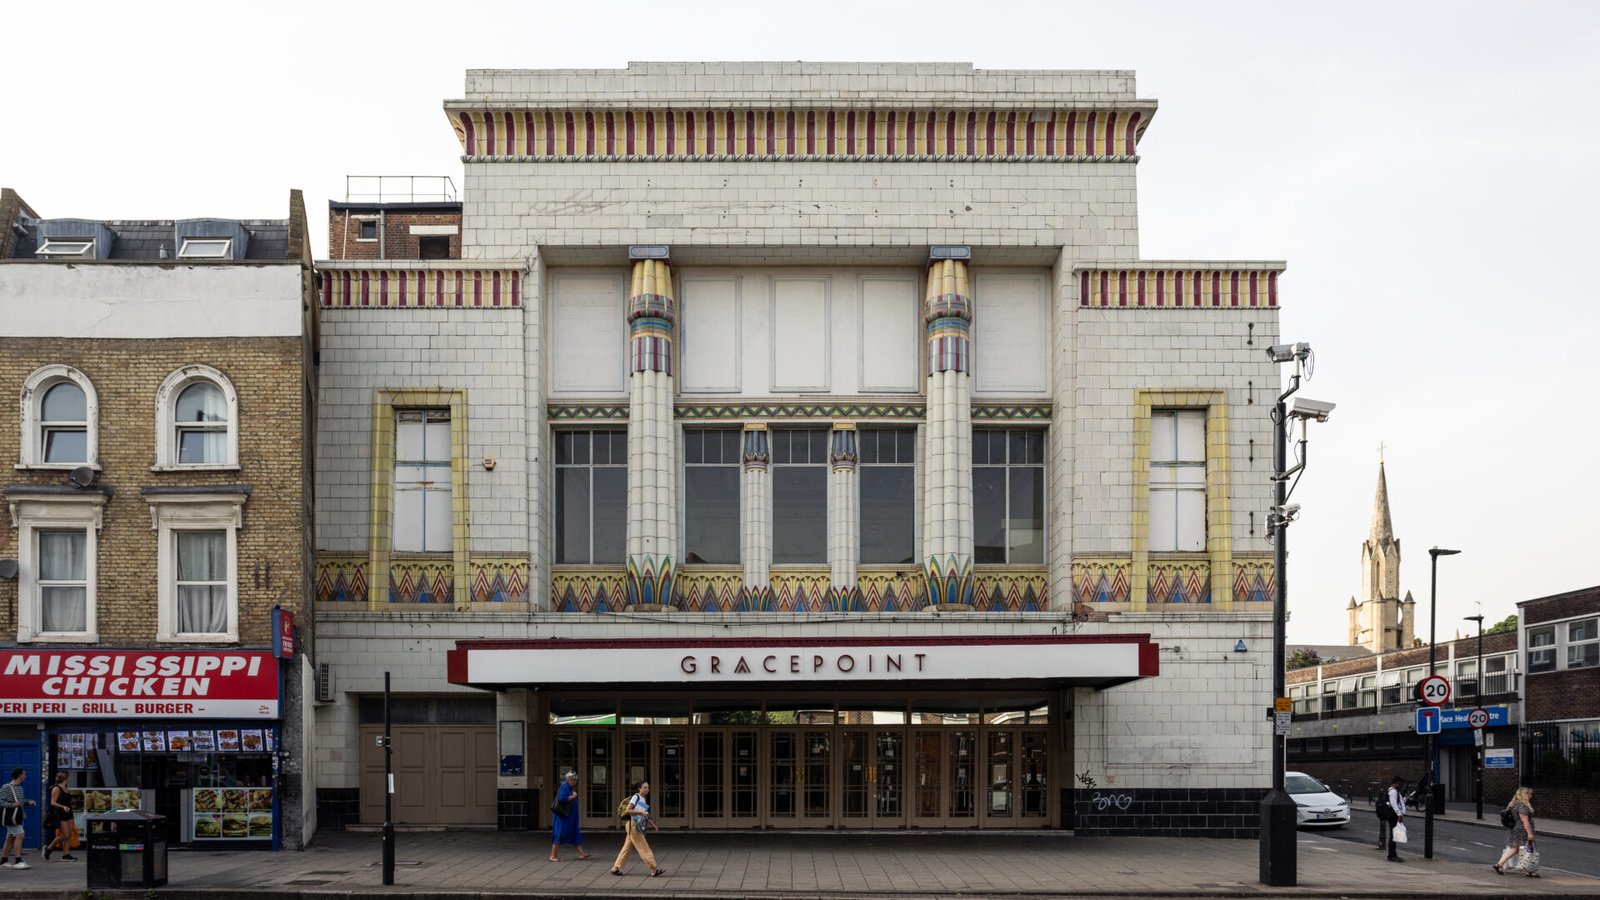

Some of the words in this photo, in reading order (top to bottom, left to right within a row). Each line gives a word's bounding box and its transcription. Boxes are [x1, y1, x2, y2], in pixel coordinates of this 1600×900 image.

[681, 654, 927, 674] GRACEPOINT
[42, 677, 211, 696] CHICKEN
[1426, 684, 1447, 697] 20
[32, 702, 67, 714] PERI
[82, 703, 117, 714] GRILL
[134, 703, 194, 714] BURGER
[1471, 714, 1487, 723] 20
